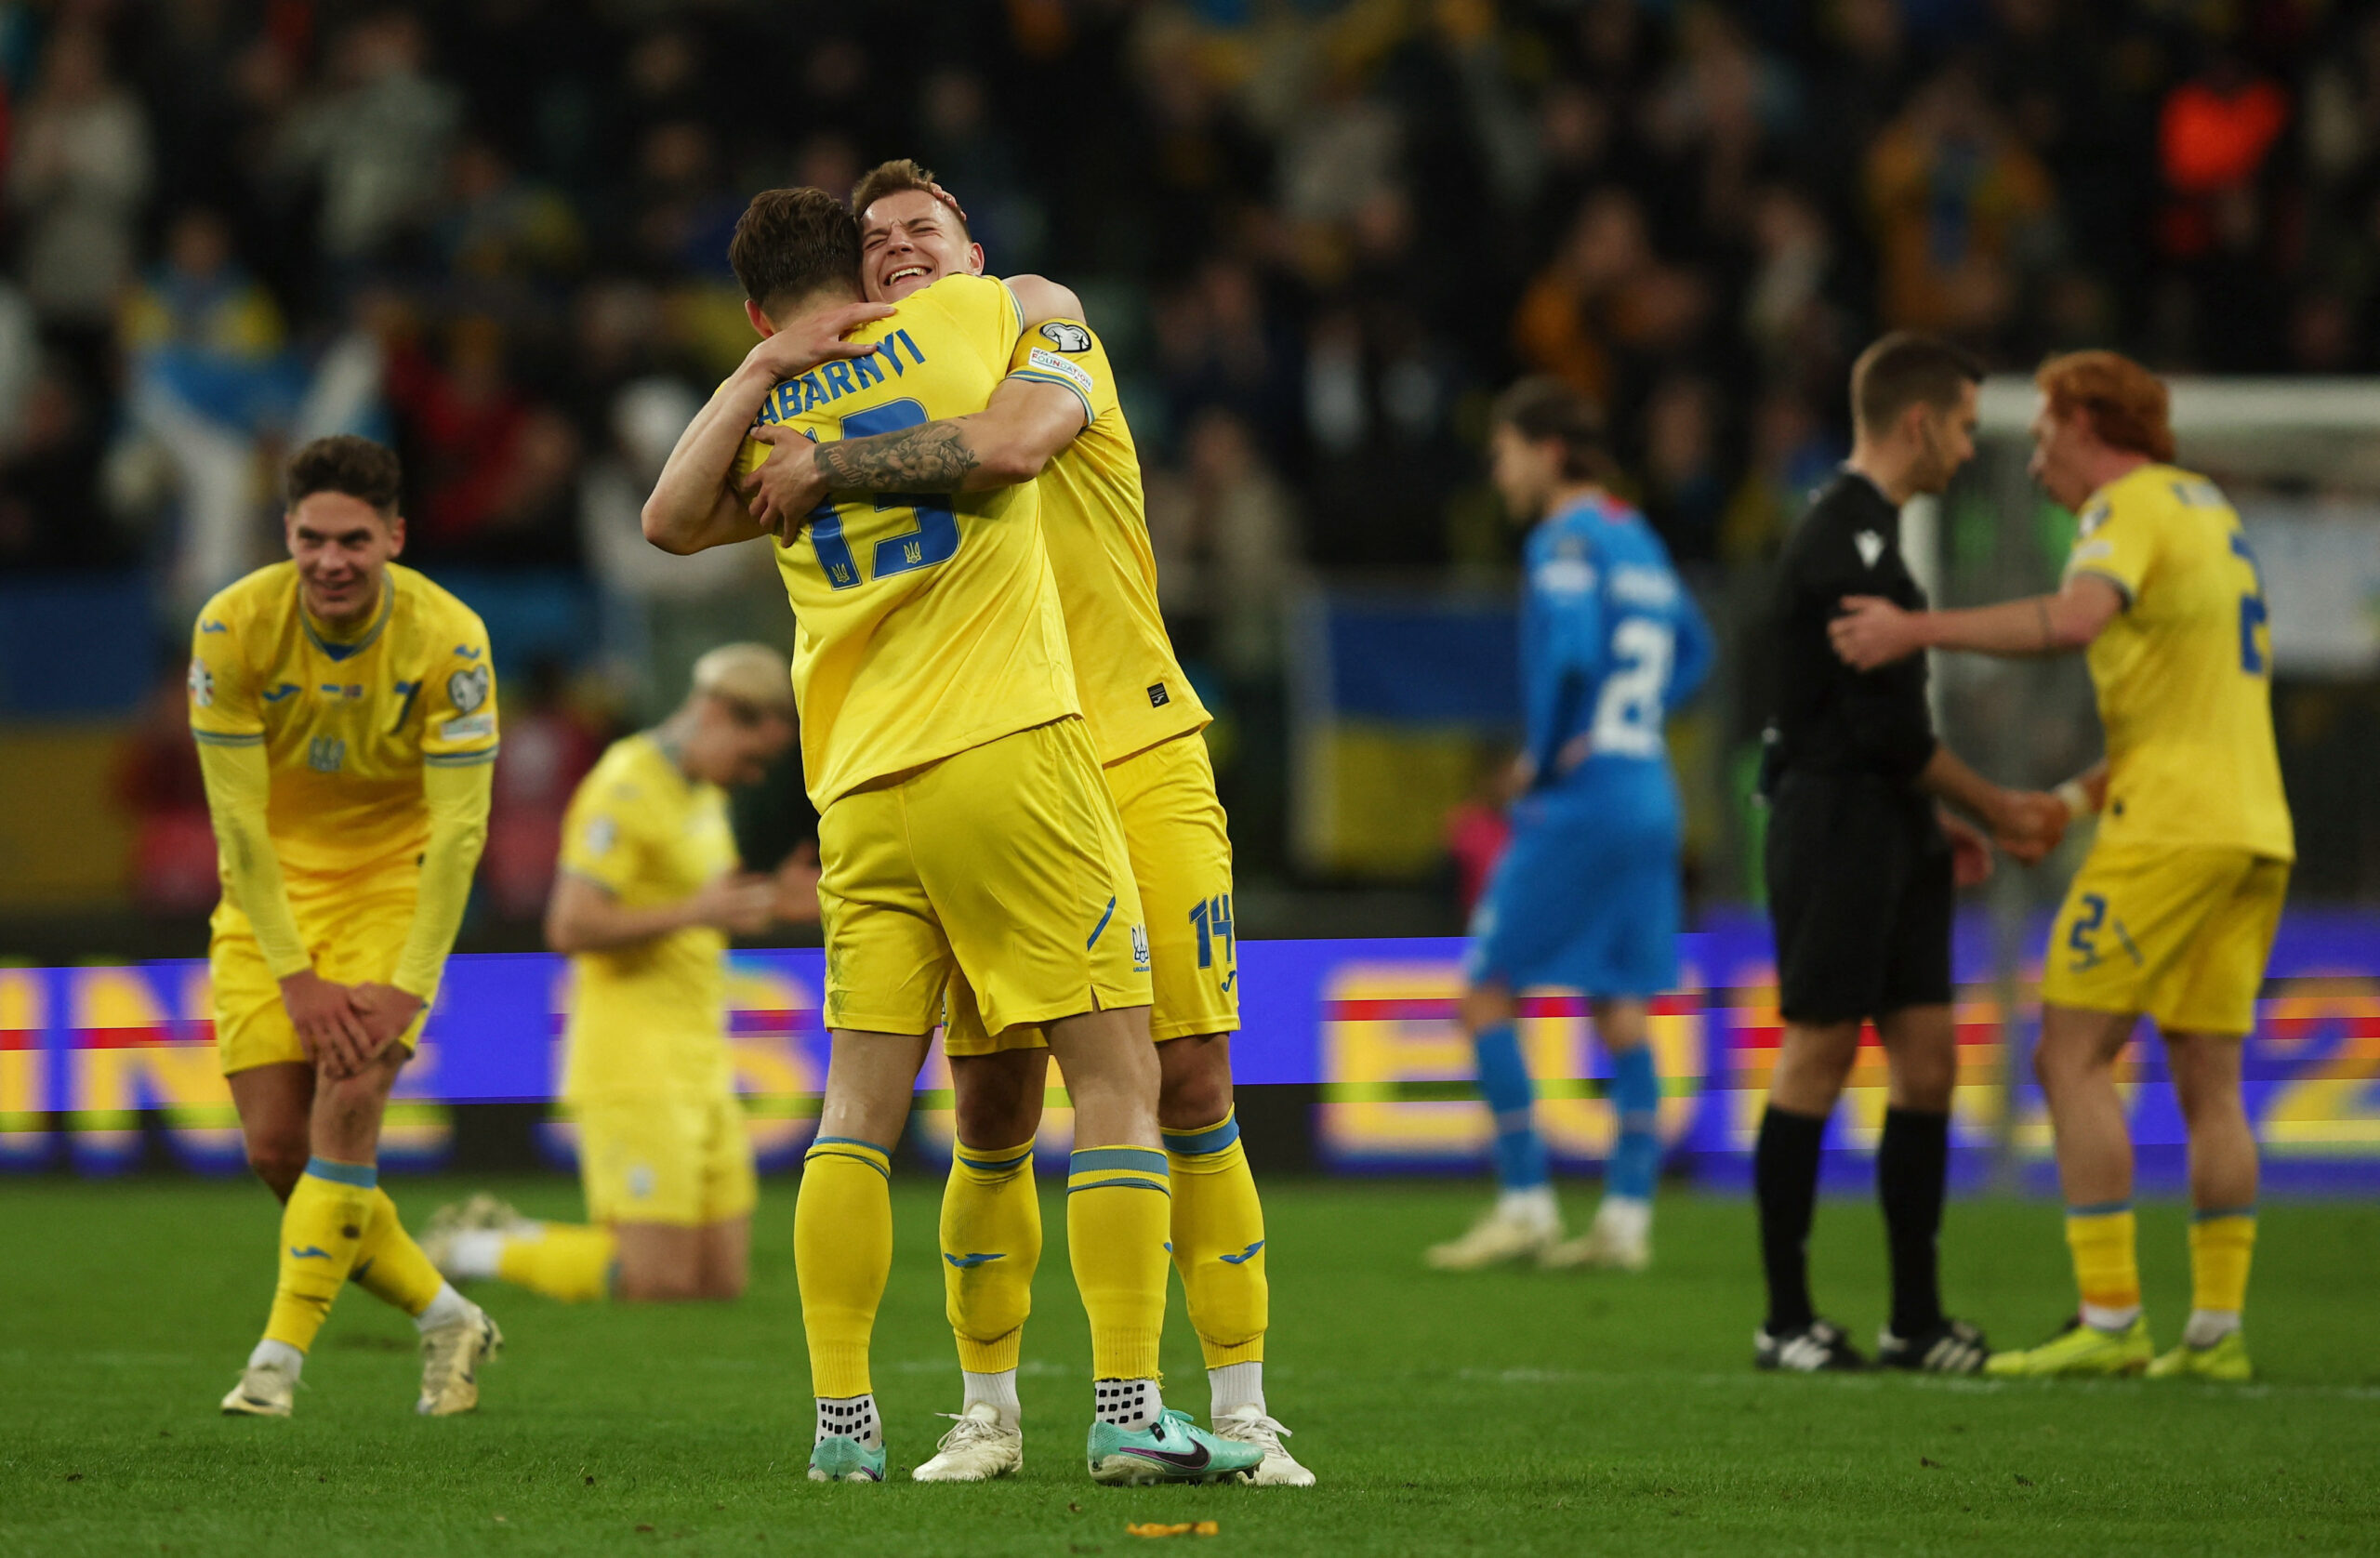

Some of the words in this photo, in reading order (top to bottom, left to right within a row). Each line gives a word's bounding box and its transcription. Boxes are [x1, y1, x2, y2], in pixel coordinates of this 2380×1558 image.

[757, 328, 926, 427] ABARNYI
[1032, 352, 1092, 388] FOUNDATION
[801, 397, 963, 591] 13
[1189, 892, 1233, 969] 14
[2069, 891, 2108, 951] 2
